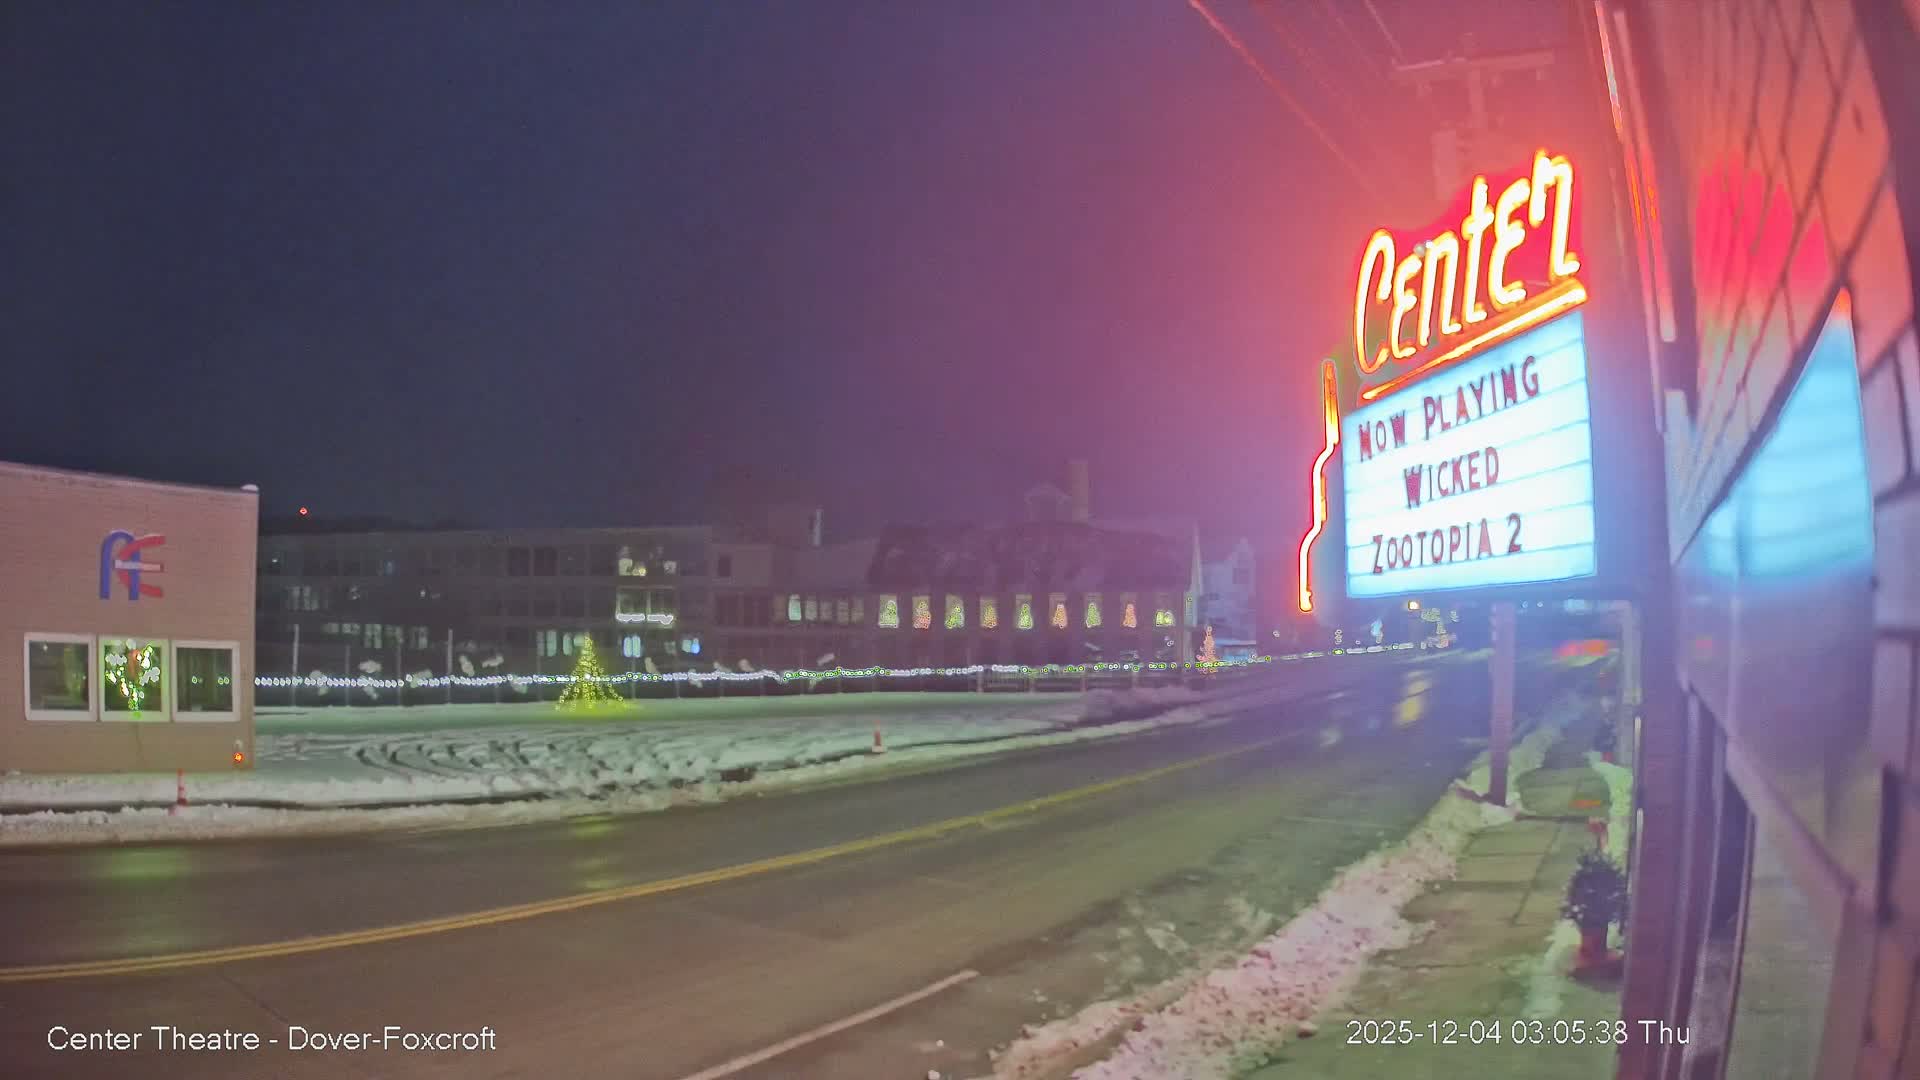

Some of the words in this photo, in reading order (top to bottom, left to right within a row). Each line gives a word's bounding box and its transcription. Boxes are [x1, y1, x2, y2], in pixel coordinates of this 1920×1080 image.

[1353, 147, 1582, 374] Center
[1358, 410, 1406, 462] NOW
[1423, 355, 1540, 441] PLAYING
[1403, 446, 1500, 510] WICKED
[1372, 519, 1493, 575] ZOOTOPIA
[1506, 512, 1524, 554] 2
